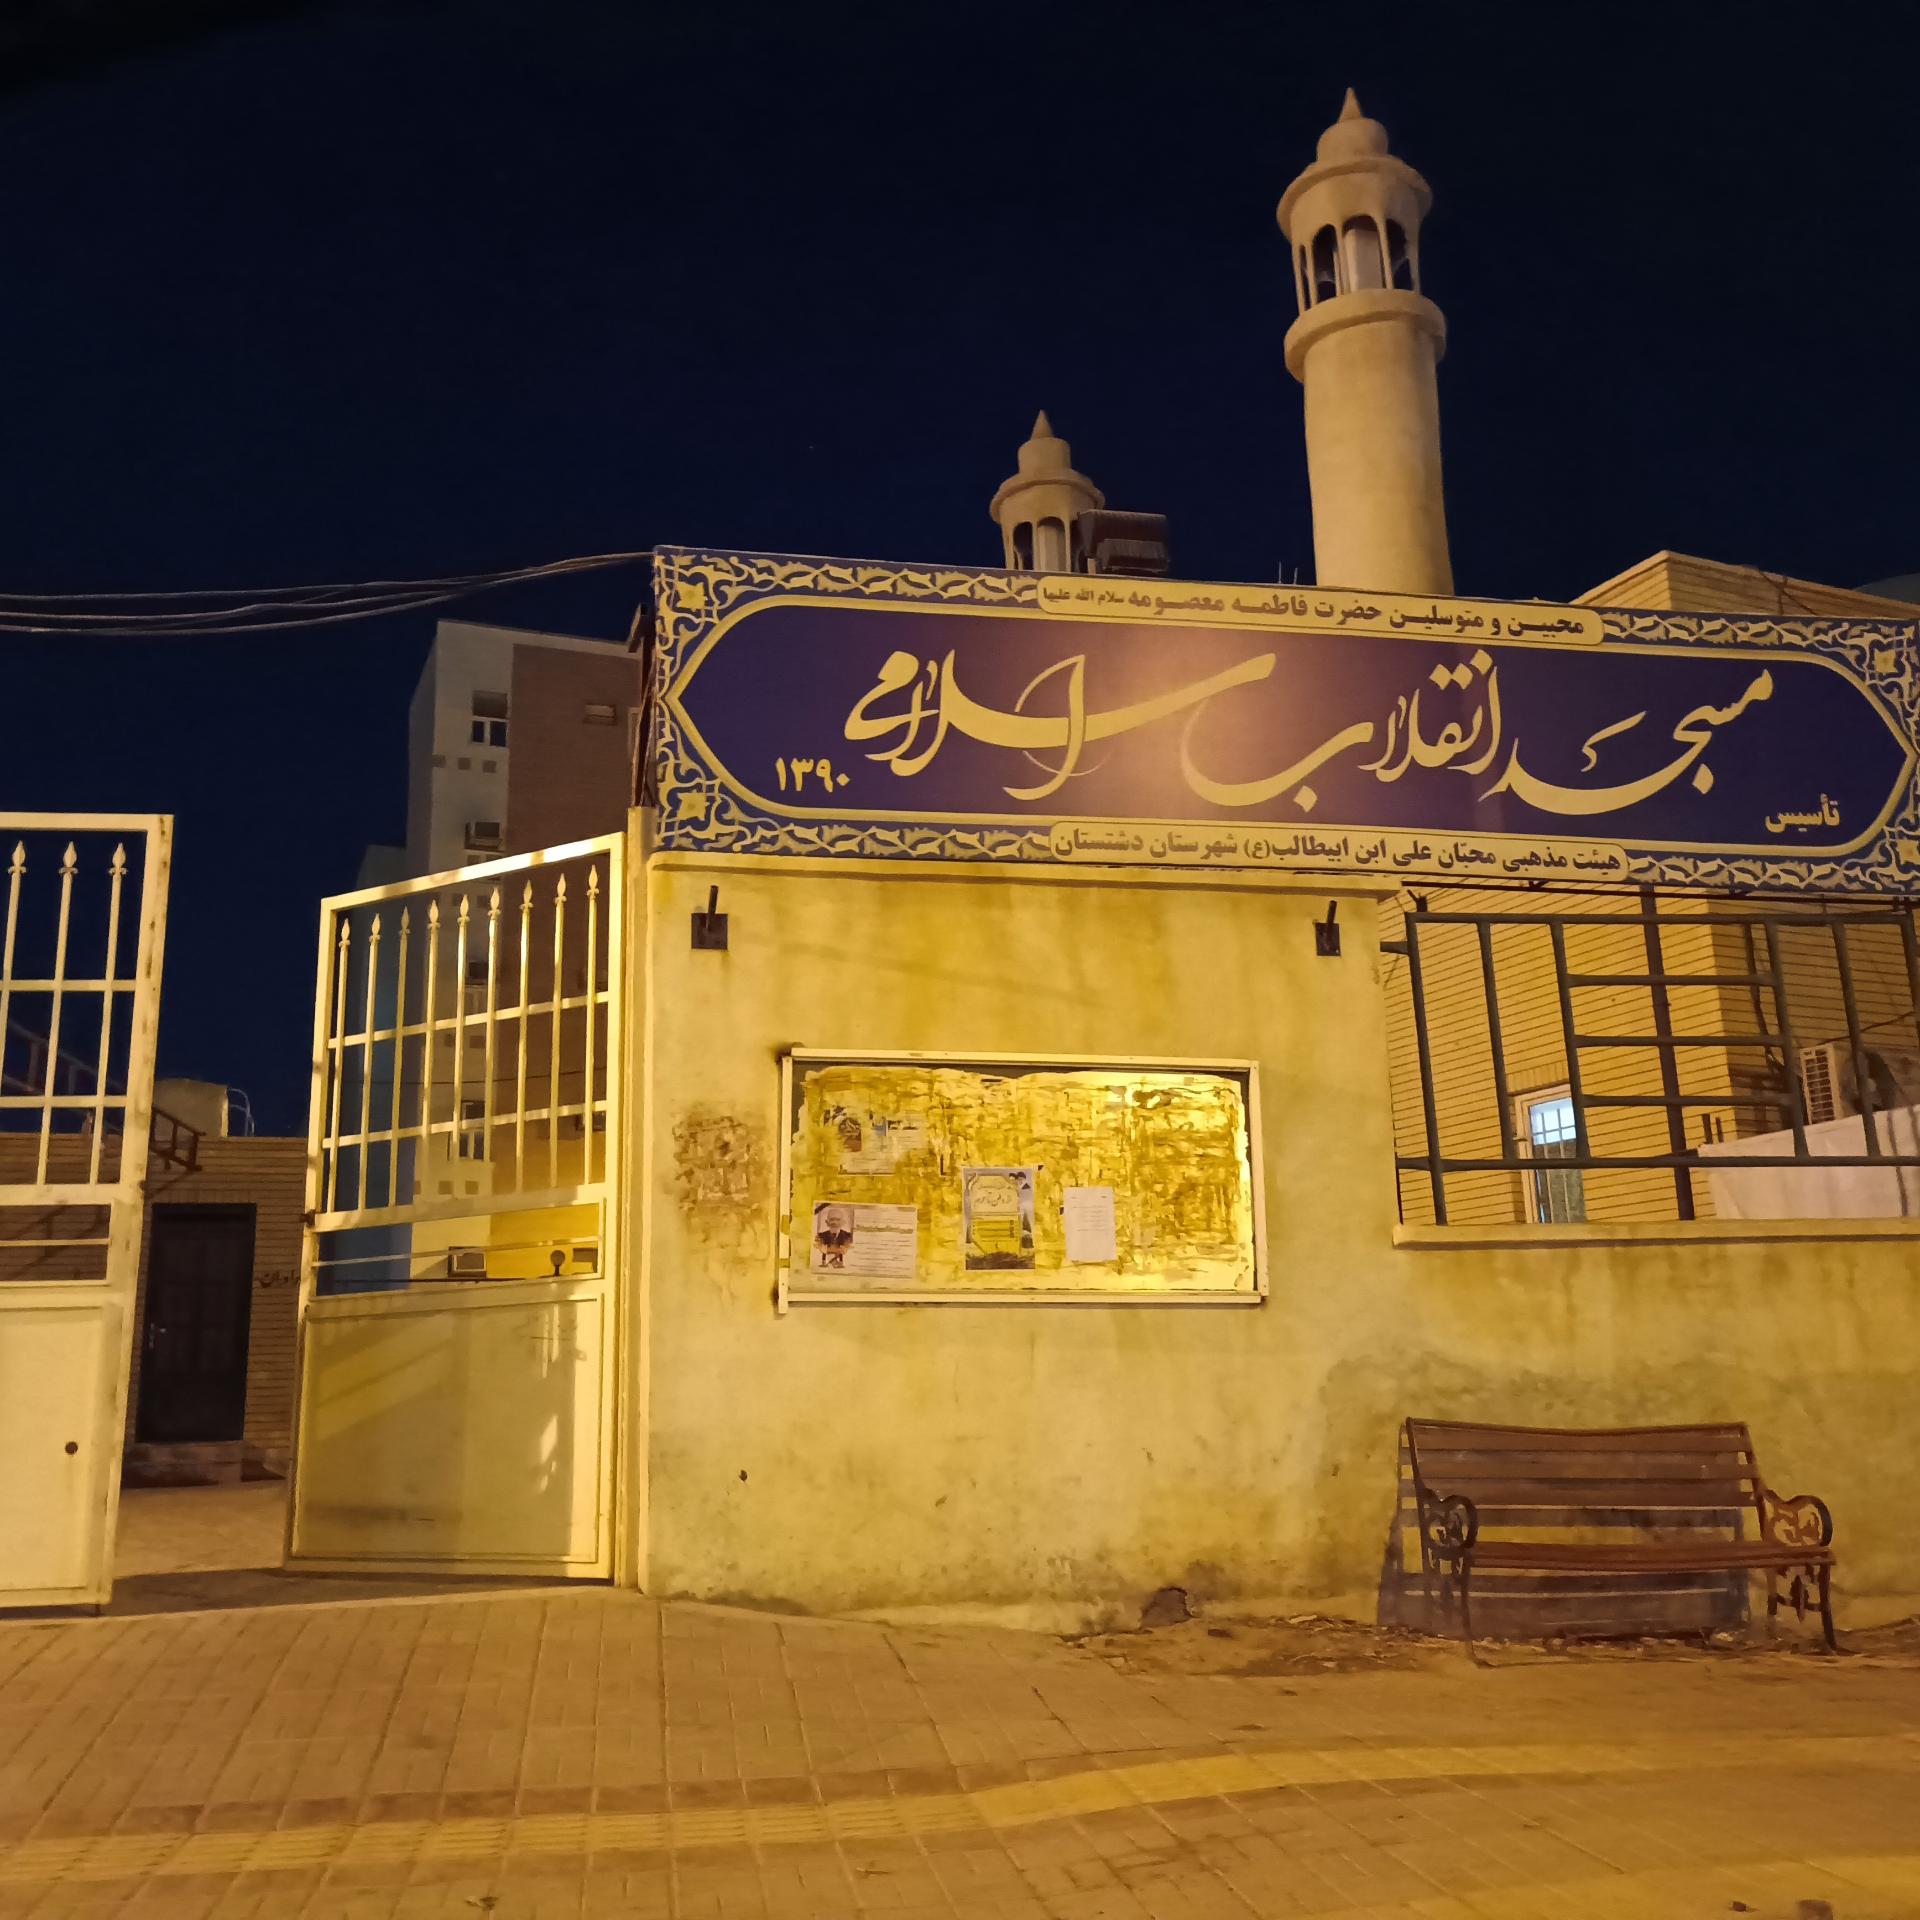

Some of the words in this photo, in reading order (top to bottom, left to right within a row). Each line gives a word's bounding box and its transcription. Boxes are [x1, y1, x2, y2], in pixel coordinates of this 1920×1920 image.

[1074, 587, 1095, 602] الله
[1097, 588, 1125, 606] سلام
[1127, 590, 1225, 615] معصومه
[1231, 593, 1309, 617] فاطمه
[1314, 599, 1382, 625] حضرت
[1389, 605, 1485, 633] متوسلین
[1491, 616, 1501, 636] و
[1507, 616, 1585, 638] محبین
[844, 649, 1276, 801] اسلامی
[1180, 649, 1501, 813] انقلاب
[1478, 669, 1774, 815] مسجد
[775, 757, 850, 793] ۱۳۹۰
[1764, 793, 1840, 833] تأسیس
[1054, 828, 1144, 857] دشتستان
[1150, 829, 1238, 860] شهرستان
[1355, 838, 1387, 864] ابن
[1392, 840, 1432, 867] علی
[1502, 846, 1568, 872] مذهبی
[1572, 849, 1621, 875] هیئت
